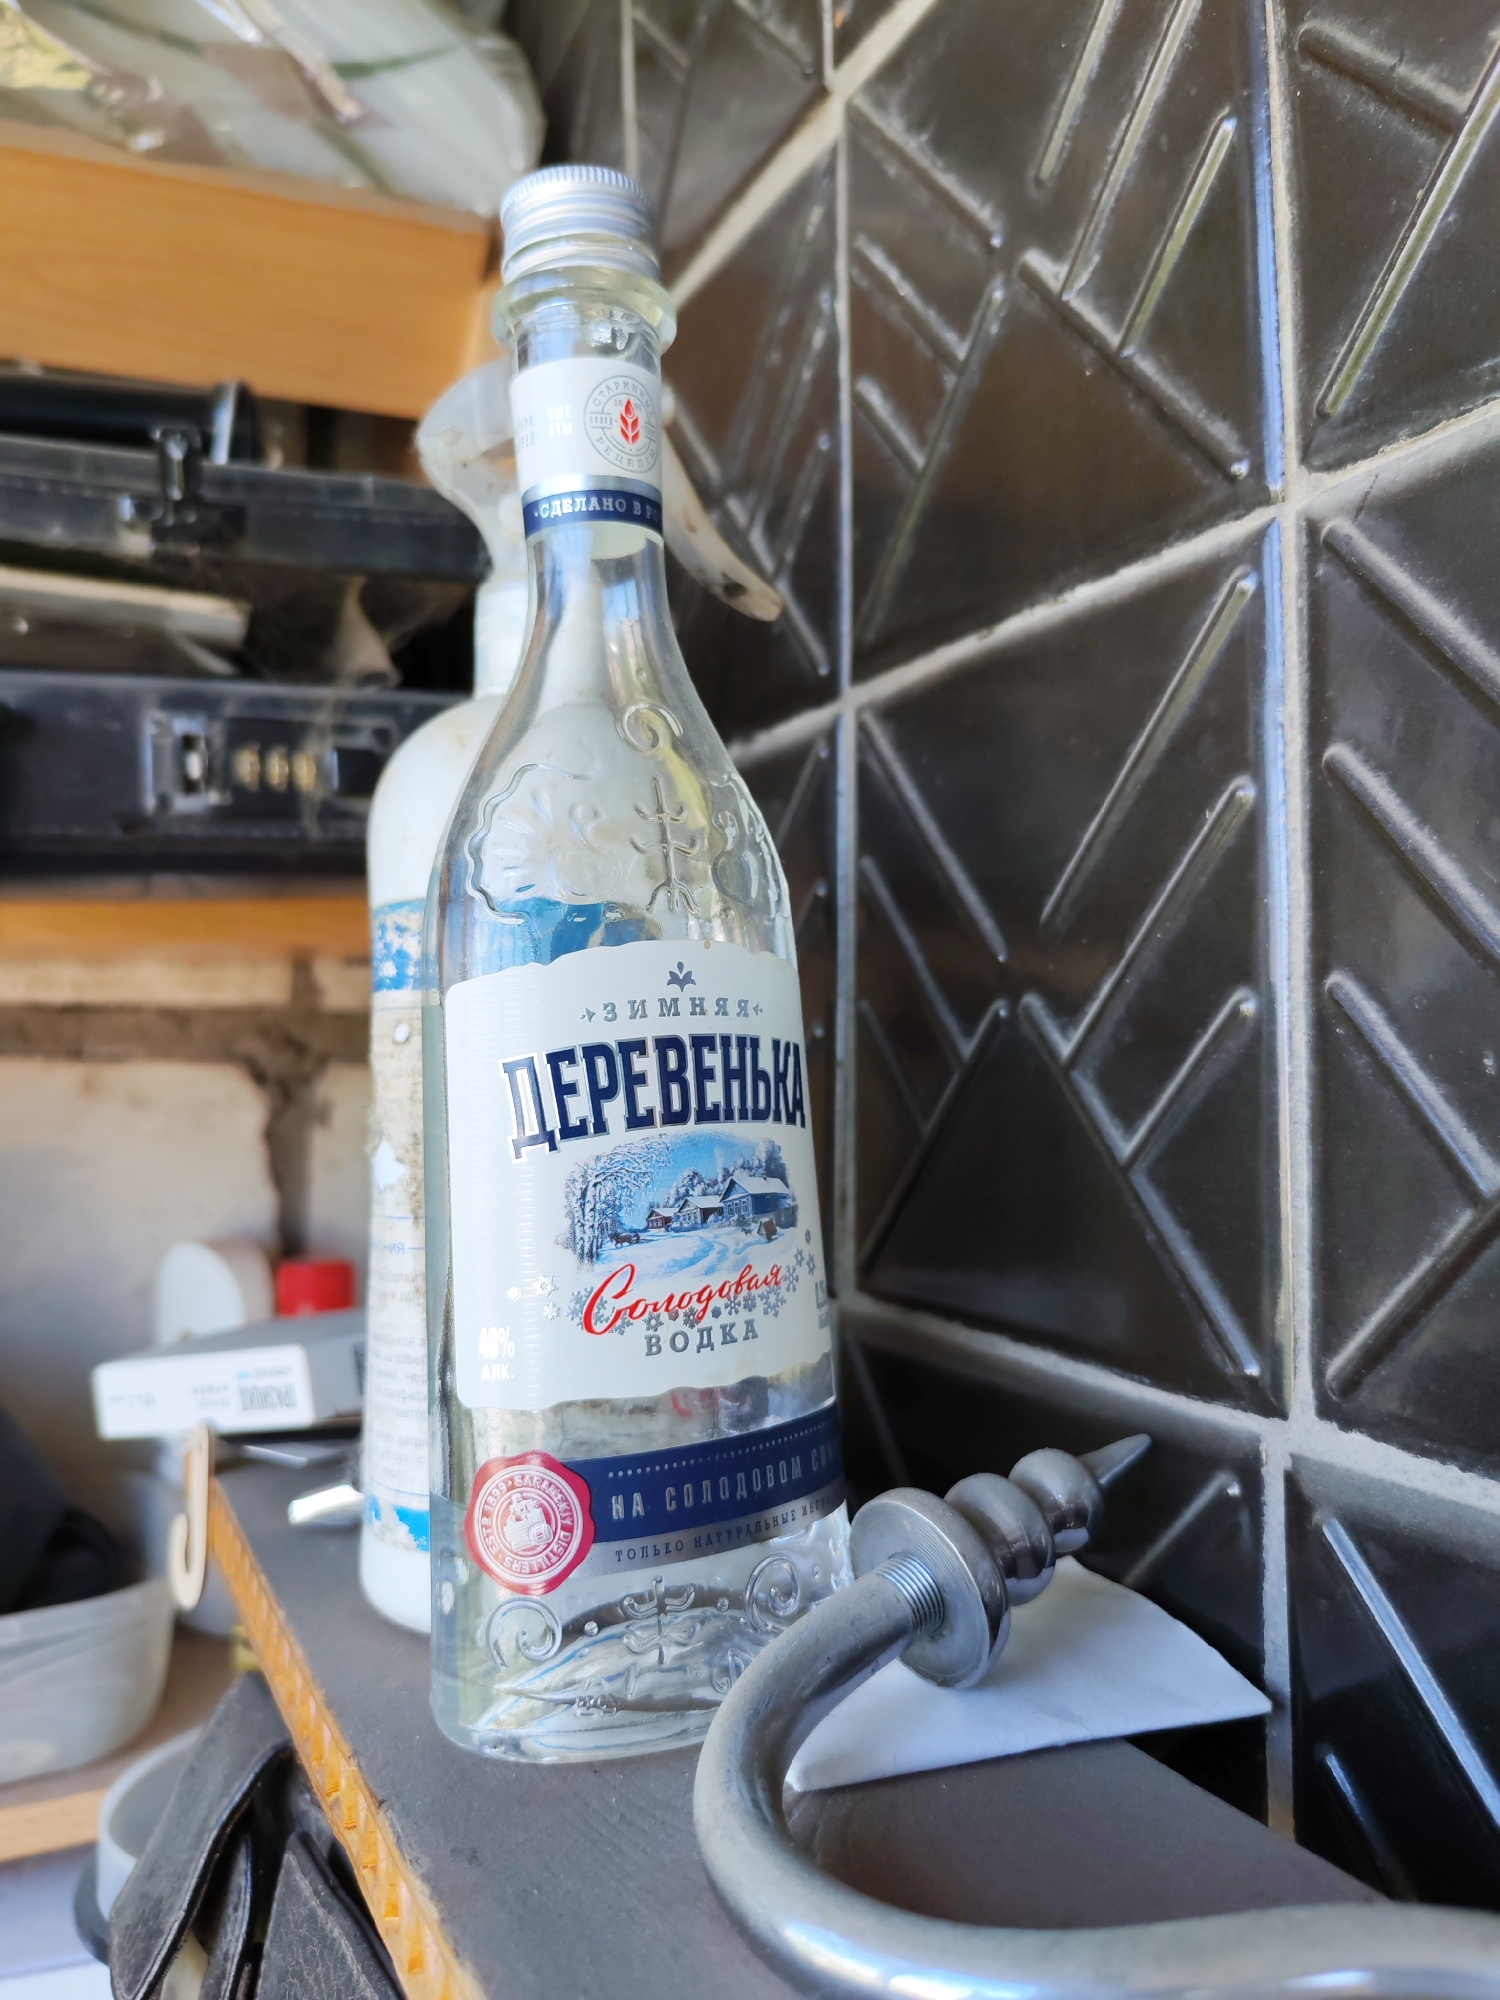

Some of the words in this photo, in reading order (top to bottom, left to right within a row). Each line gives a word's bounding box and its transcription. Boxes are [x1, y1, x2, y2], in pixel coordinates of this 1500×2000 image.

[539, 495, 627, 520] СДЕЛАНО
[633, 499, 642, 516] В
[602, 996, 750, 1022] ЗИМНЯЯ
[498, 1032, 807, 1164] ДЕРЕВЕНЬКА
[582, 1262, 786, 1336] Солодовая
[478, 1326, 516, 1361] 40%
[644, 1317, 760, 1357] ВОДКА
[483, 1480, 509, 1512] 1899
[611, 1491, 646, 1522] НА
[665, 1456, 802, 1511] СОЛОДОВОМ
[503, 1531, 572, 1574] DISTILLERS
[615, 1539, 686, 1562] ТОЛЬКО
[693, 1507, 797, 1548] НАТУРАЛЬНЫЕ
